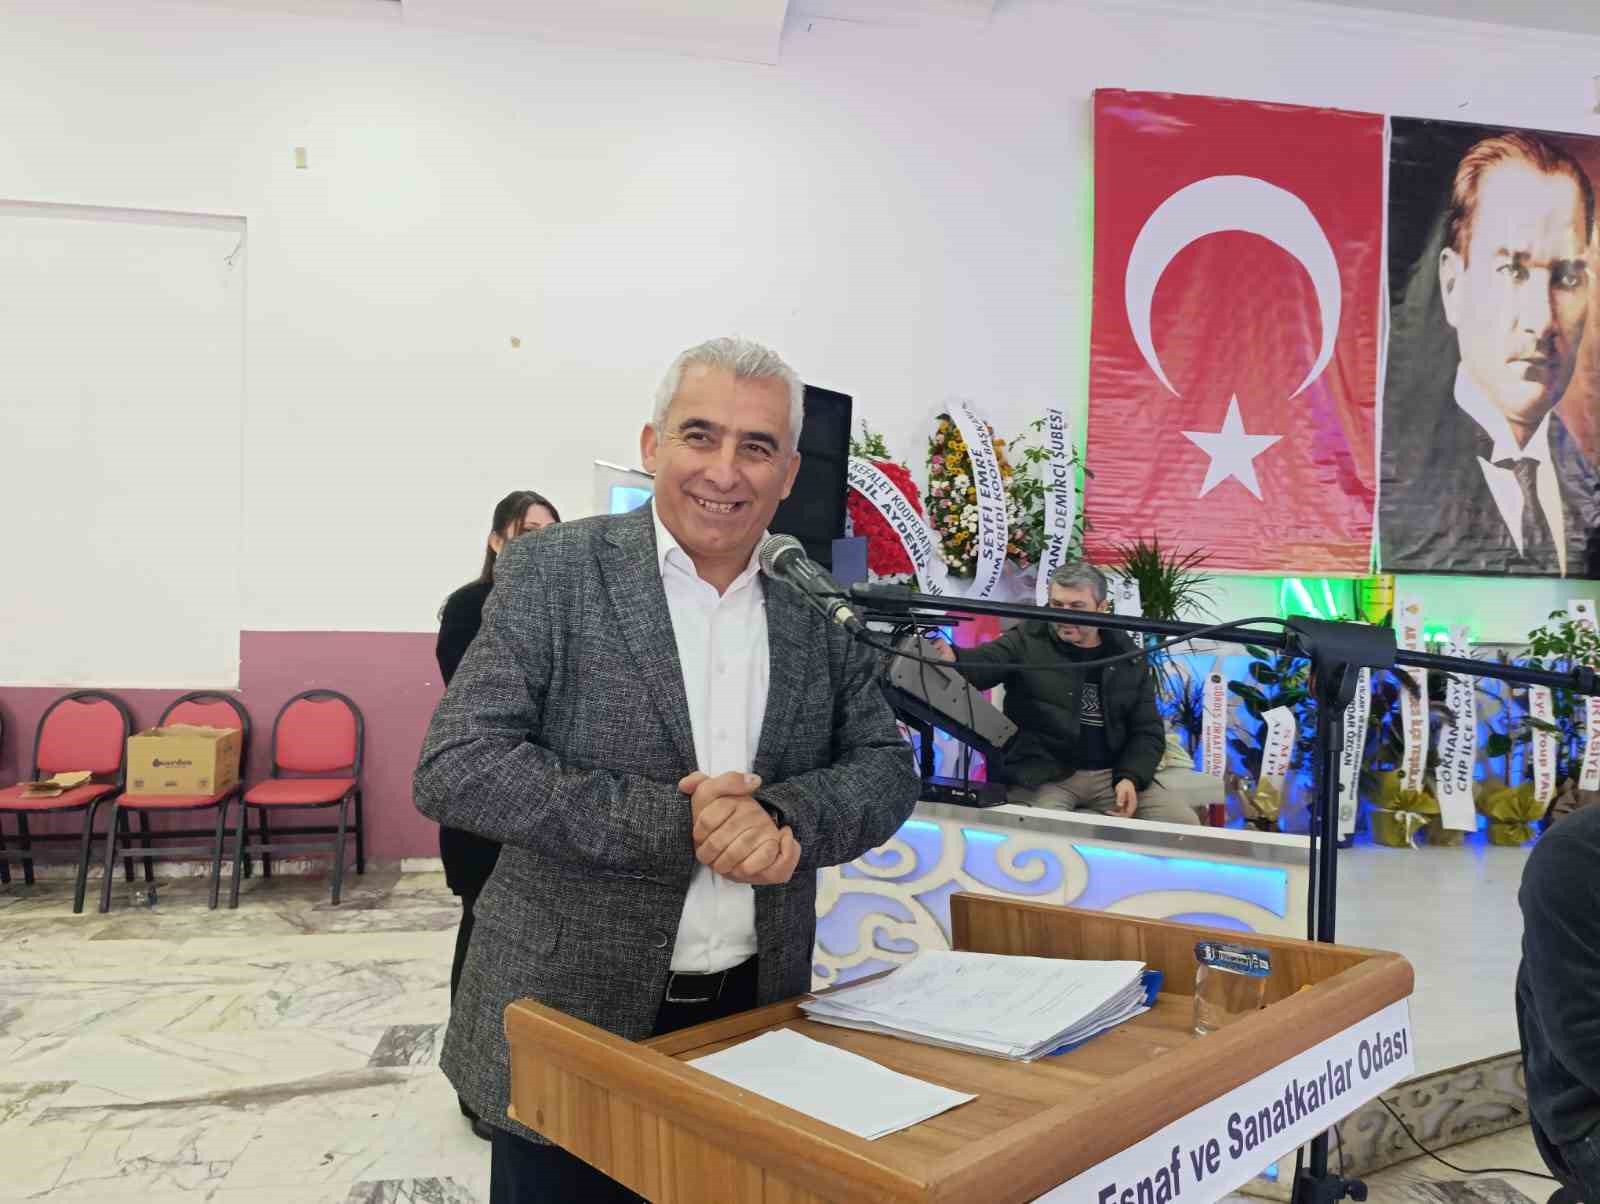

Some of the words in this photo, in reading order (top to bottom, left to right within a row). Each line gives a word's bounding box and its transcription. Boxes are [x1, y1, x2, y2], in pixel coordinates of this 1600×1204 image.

[972, 448, 992, 498] EMRE
[1049, 463, 1067, 528] DEMİRCİ
[979, 557, 1002, 599] TARIM
[1344, 731, 1358, 767] ÖZCAN
[1442, 725, 1459, 796] GÖKHAN
[1459, 723, 1473, 757] İLÇE
[1456, 760, 1469, 793] CHP
[1190, 1138, 1221, 1182] ve
[1227, 1060, 1353, 1160] Sanatkarlar
[1358, 1027, 1408, 1080] Odası
